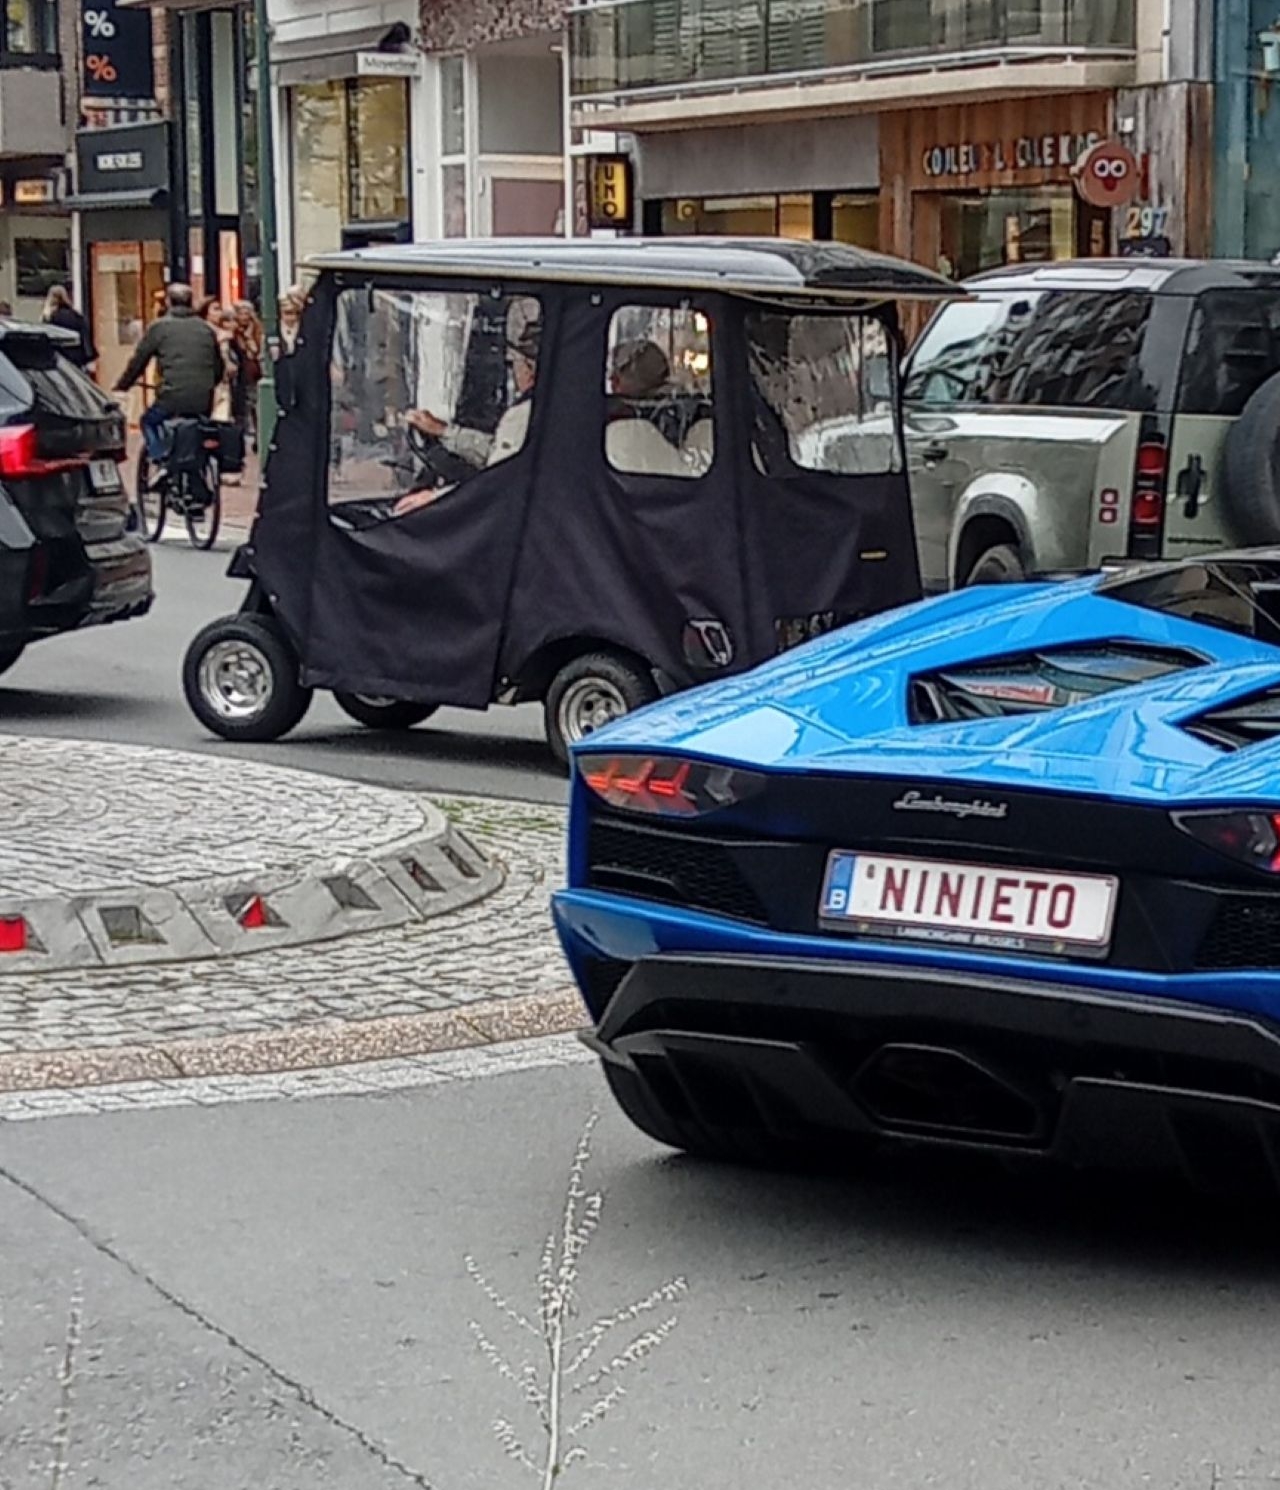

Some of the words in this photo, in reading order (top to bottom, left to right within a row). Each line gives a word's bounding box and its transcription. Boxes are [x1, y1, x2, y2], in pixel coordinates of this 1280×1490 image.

[893, 790, 1007, 818] Lamborghini
[831, 889, 847, 909] B
[879, 866, 1077, 929] NINIETO
